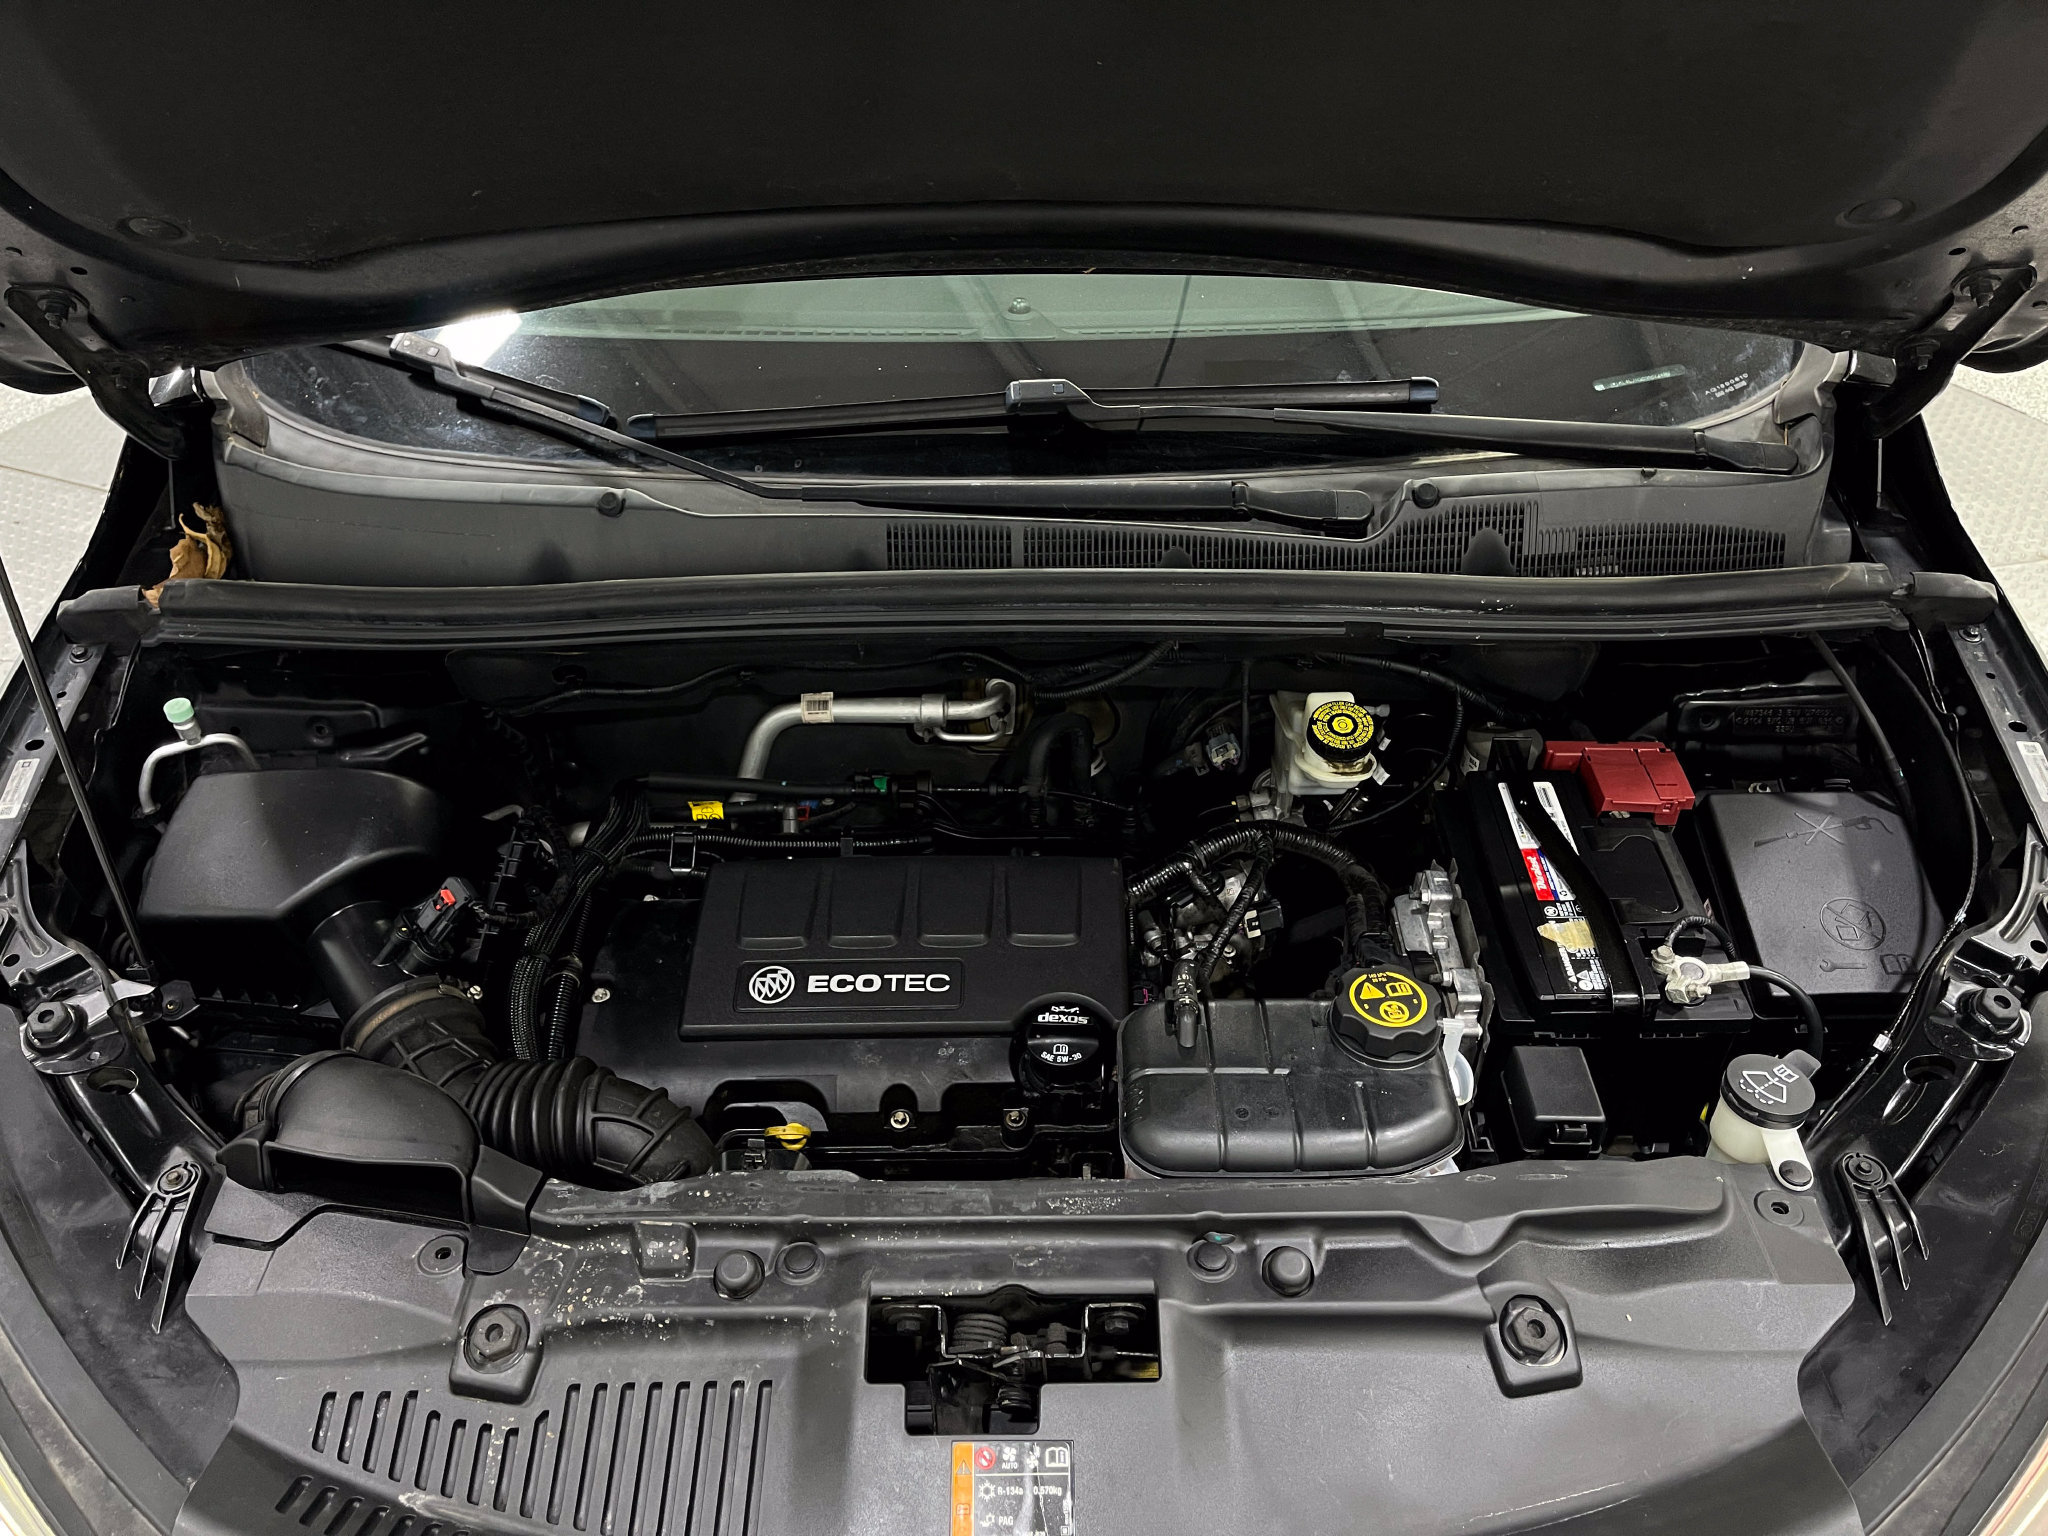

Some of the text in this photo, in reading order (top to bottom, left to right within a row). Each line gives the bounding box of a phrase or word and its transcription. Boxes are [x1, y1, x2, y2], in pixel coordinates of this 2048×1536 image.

[807, 973, 951, 993] ECOTEC
[1037, 1012, 1090, 1025] dexos
[1040, 1051, 1082, 1063] SAE 5W-30
[1001, 1461, 1018, 1470] AUTO
[997, 1485, 1024, 1496] R-134a
[998, 1515, 1014, 1526] PAG
